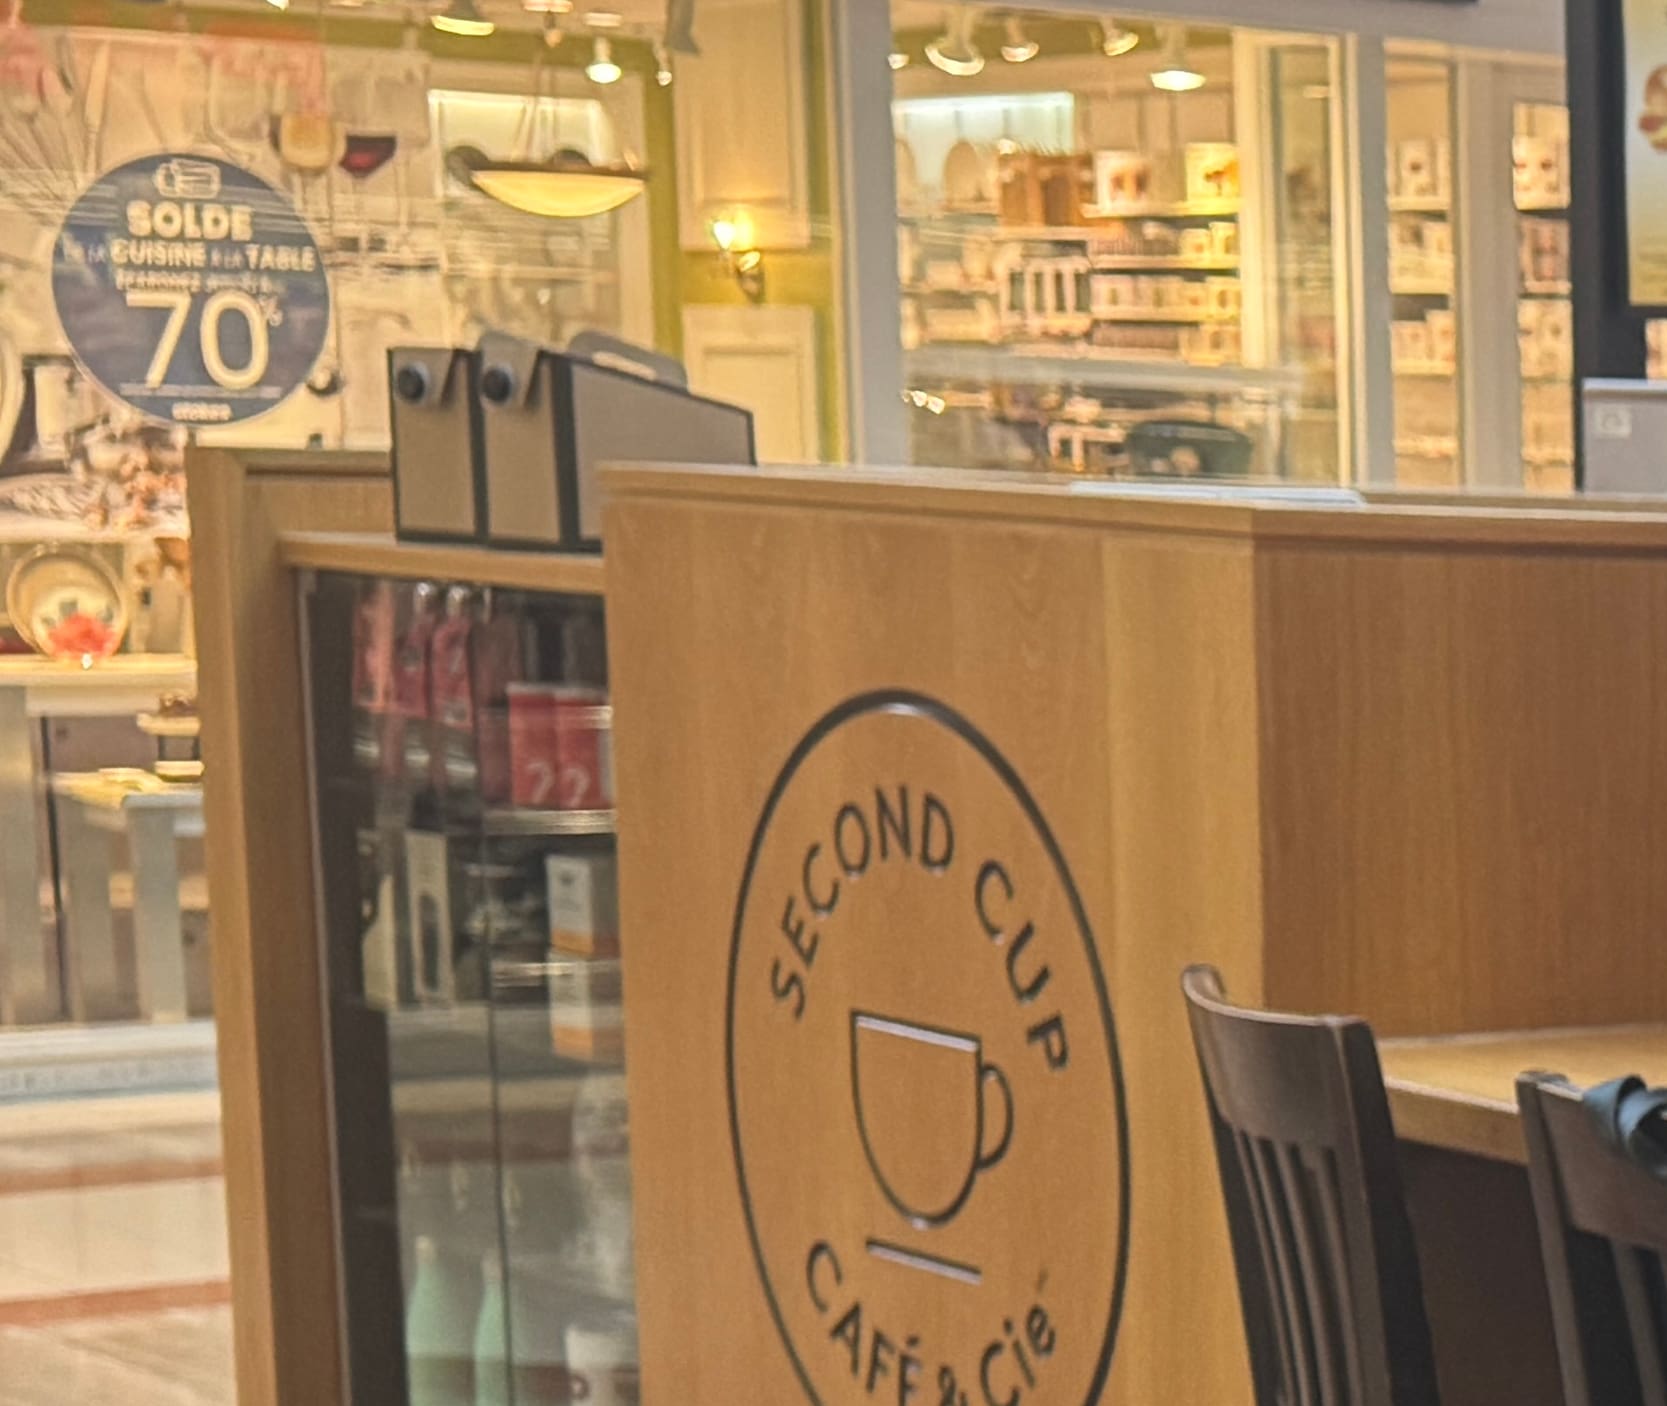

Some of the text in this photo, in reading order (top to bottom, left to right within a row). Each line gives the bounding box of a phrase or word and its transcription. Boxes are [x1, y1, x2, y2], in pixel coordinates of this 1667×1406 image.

[126, 200, 254, 241] SOLDE
[110, 238, 208, 268] CUISINE
[246, 243, 316, 272] TABLE
[769, 783, 1070, 1072] SECOND CUP
